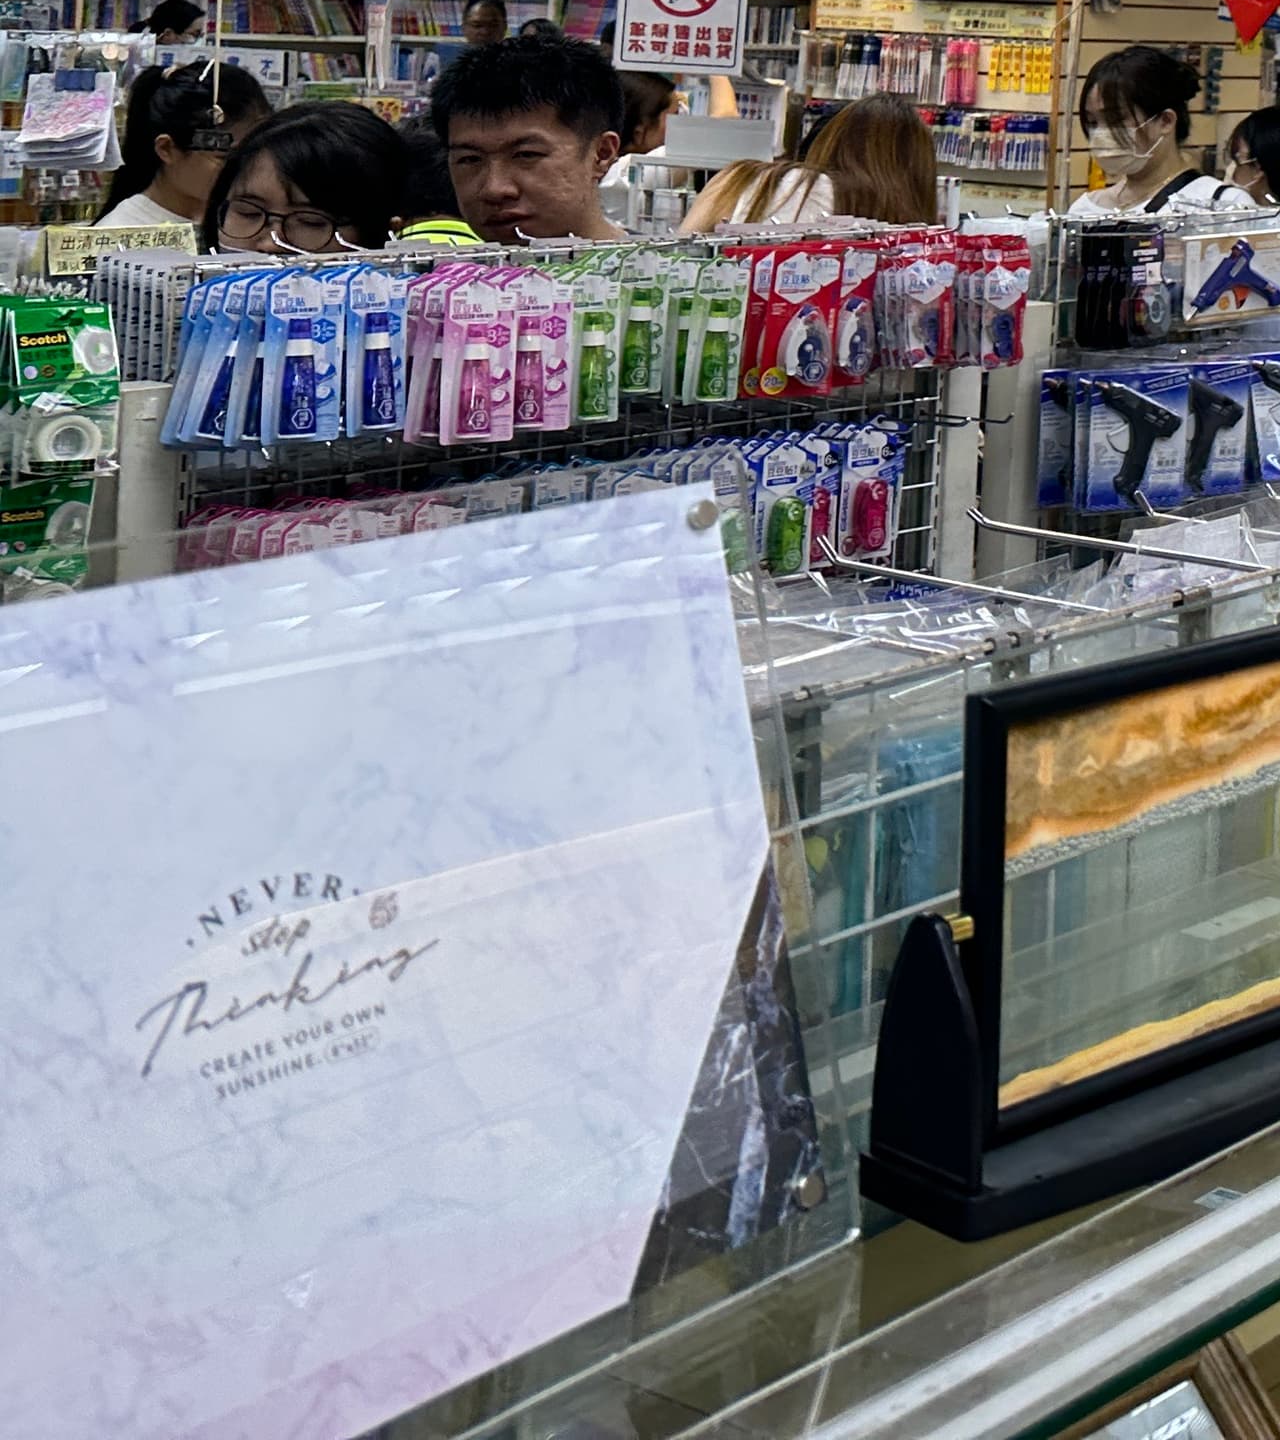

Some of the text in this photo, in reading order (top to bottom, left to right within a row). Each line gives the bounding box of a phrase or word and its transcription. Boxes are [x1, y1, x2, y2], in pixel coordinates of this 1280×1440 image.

[19, 333, 67, 346] Scotch
[2, 511, 44, 523] Scotch
[135, 938, 440, 1078] Thinking
[200, 1003, 386, 1078] CREATE YOUR OWN
